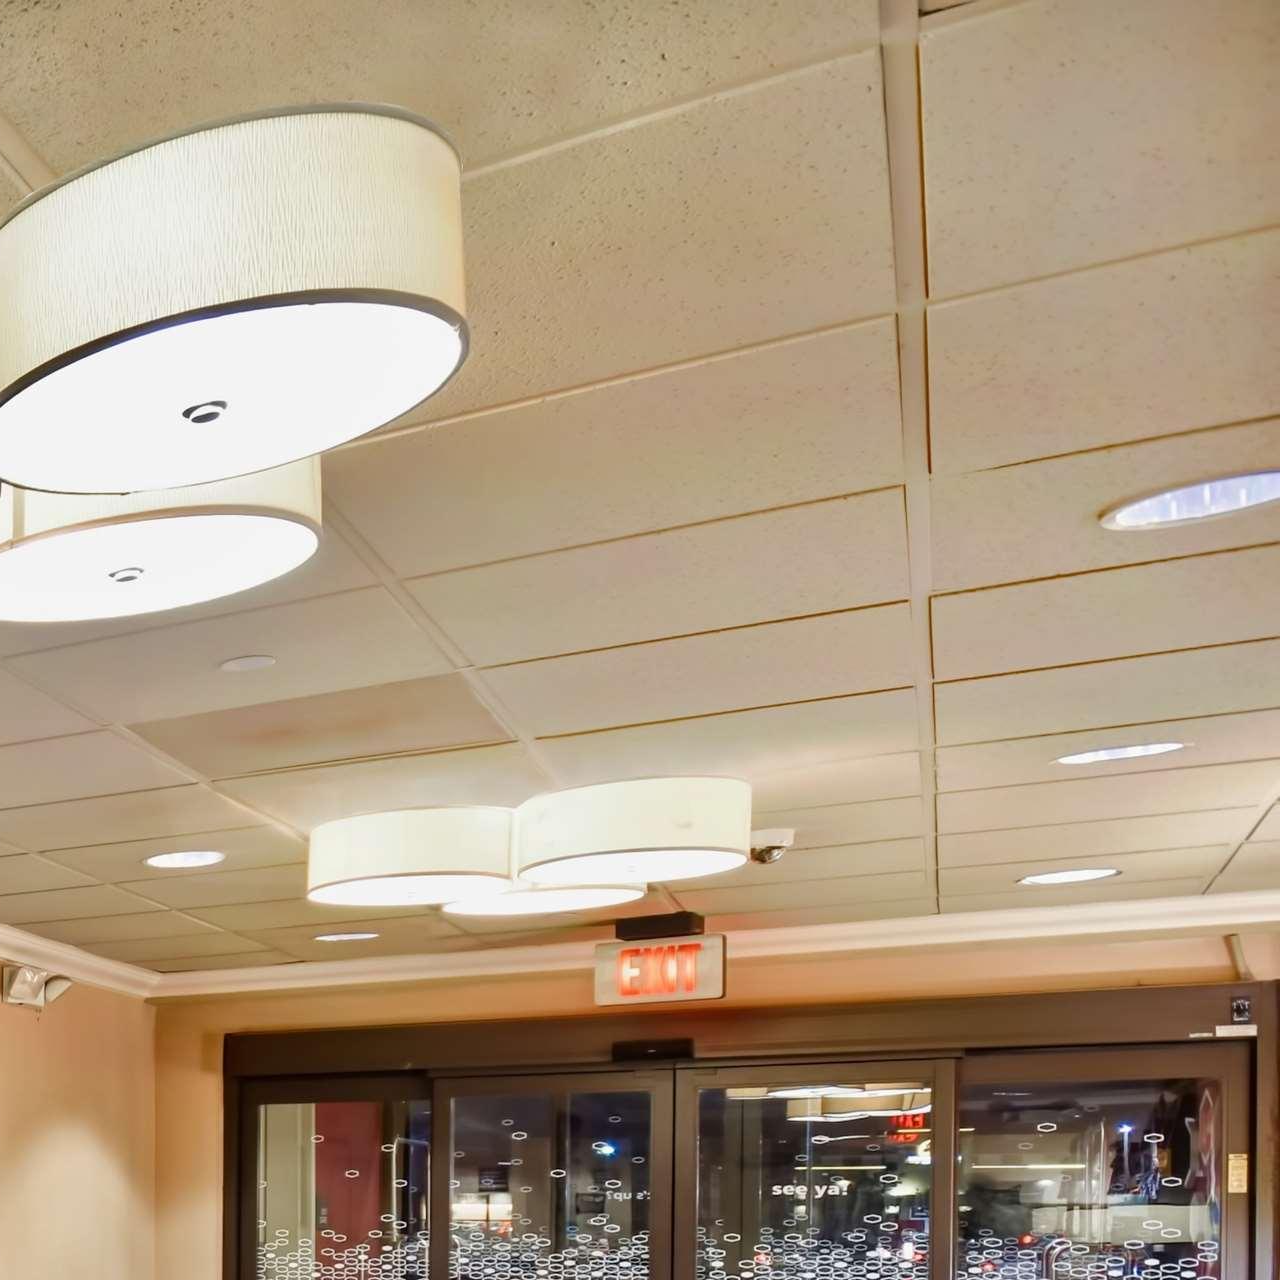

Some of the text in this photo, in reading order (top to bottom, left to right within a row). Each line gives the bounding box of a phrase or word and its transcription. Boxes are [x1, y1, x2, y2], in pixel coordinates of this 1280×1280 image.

[620, 943, 703, 996] EXIT
[772, 1183, 849, 1199] see ya!
